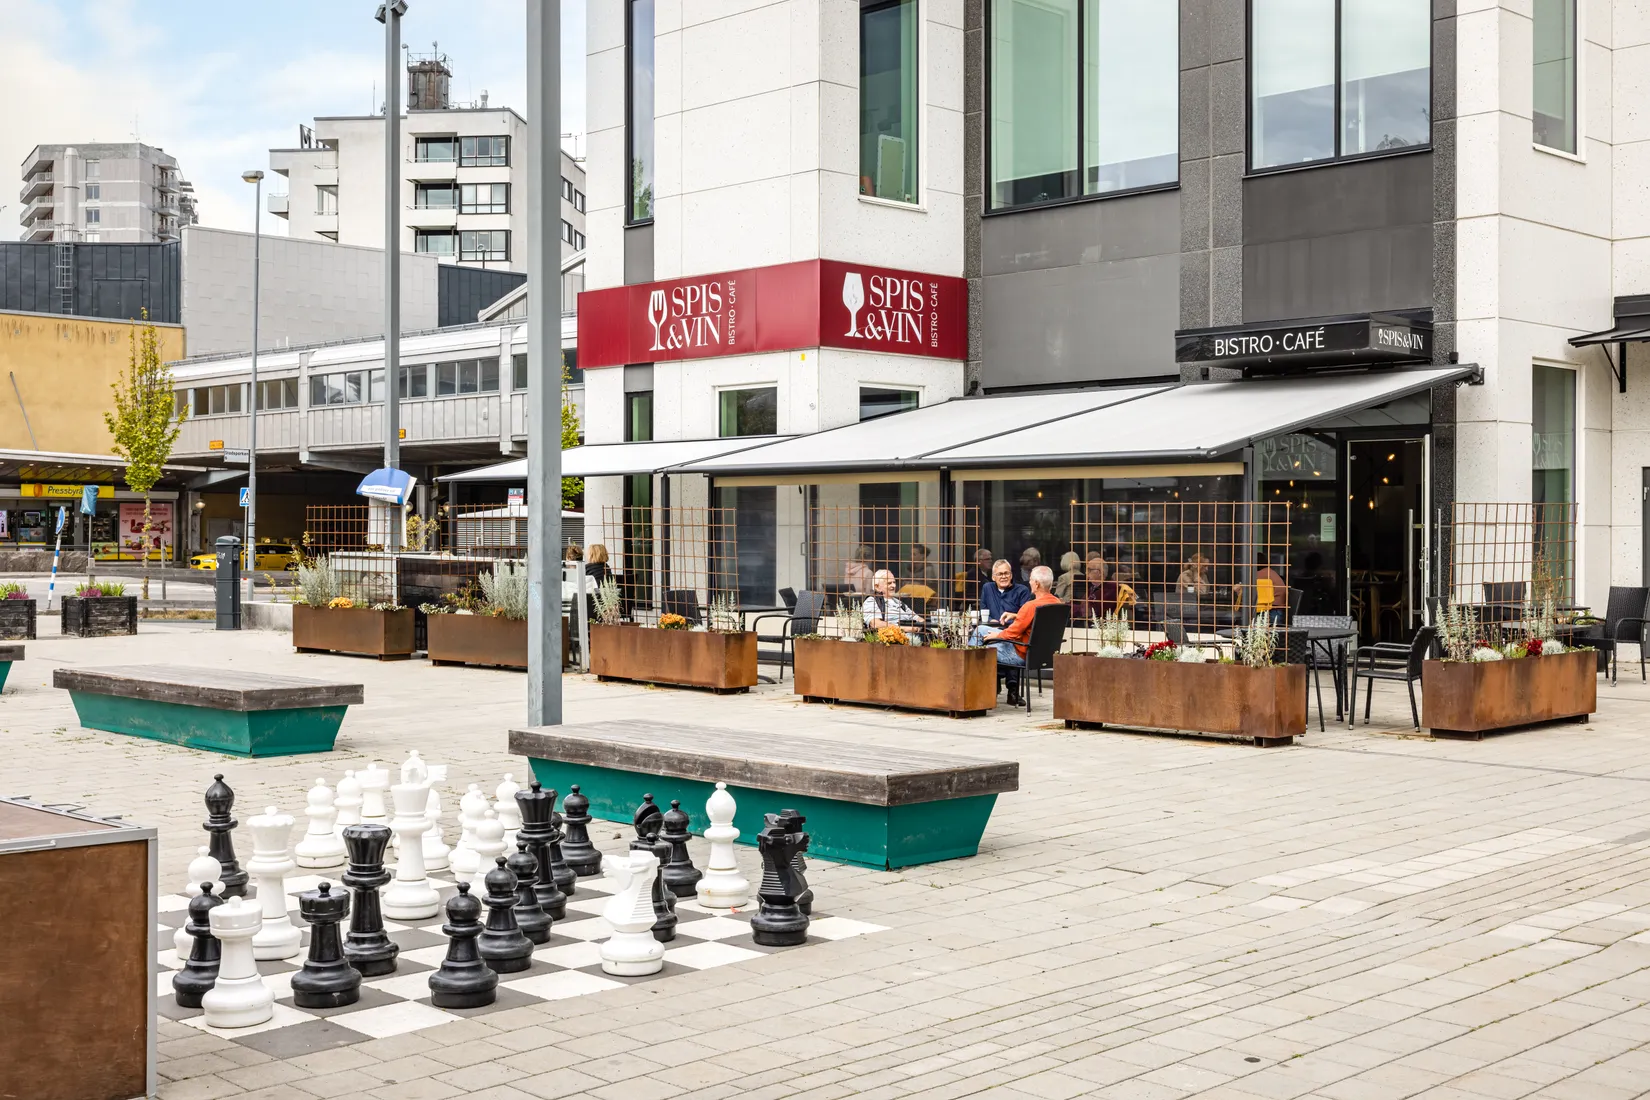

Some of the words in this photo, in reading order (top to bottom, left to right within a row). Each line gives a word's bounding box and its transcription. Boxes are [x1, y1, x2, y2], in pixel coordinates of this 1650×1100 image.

[671, 281, 722, 318] SPIS
[727, 279, 736, 304] CAFÉ
[869, 274, 924, 312] SPIS
[929, 282, 938, 307] CAFÉ
[728, 309, 736, 345] BISTRO
[930, 312, 938, 348] BISTRO
[1215, 335, 1273, 356] BISTRO
[1283, 326, 1325, 351] CAFÉ
[47, 485, 84, 496] Pressbyrå
